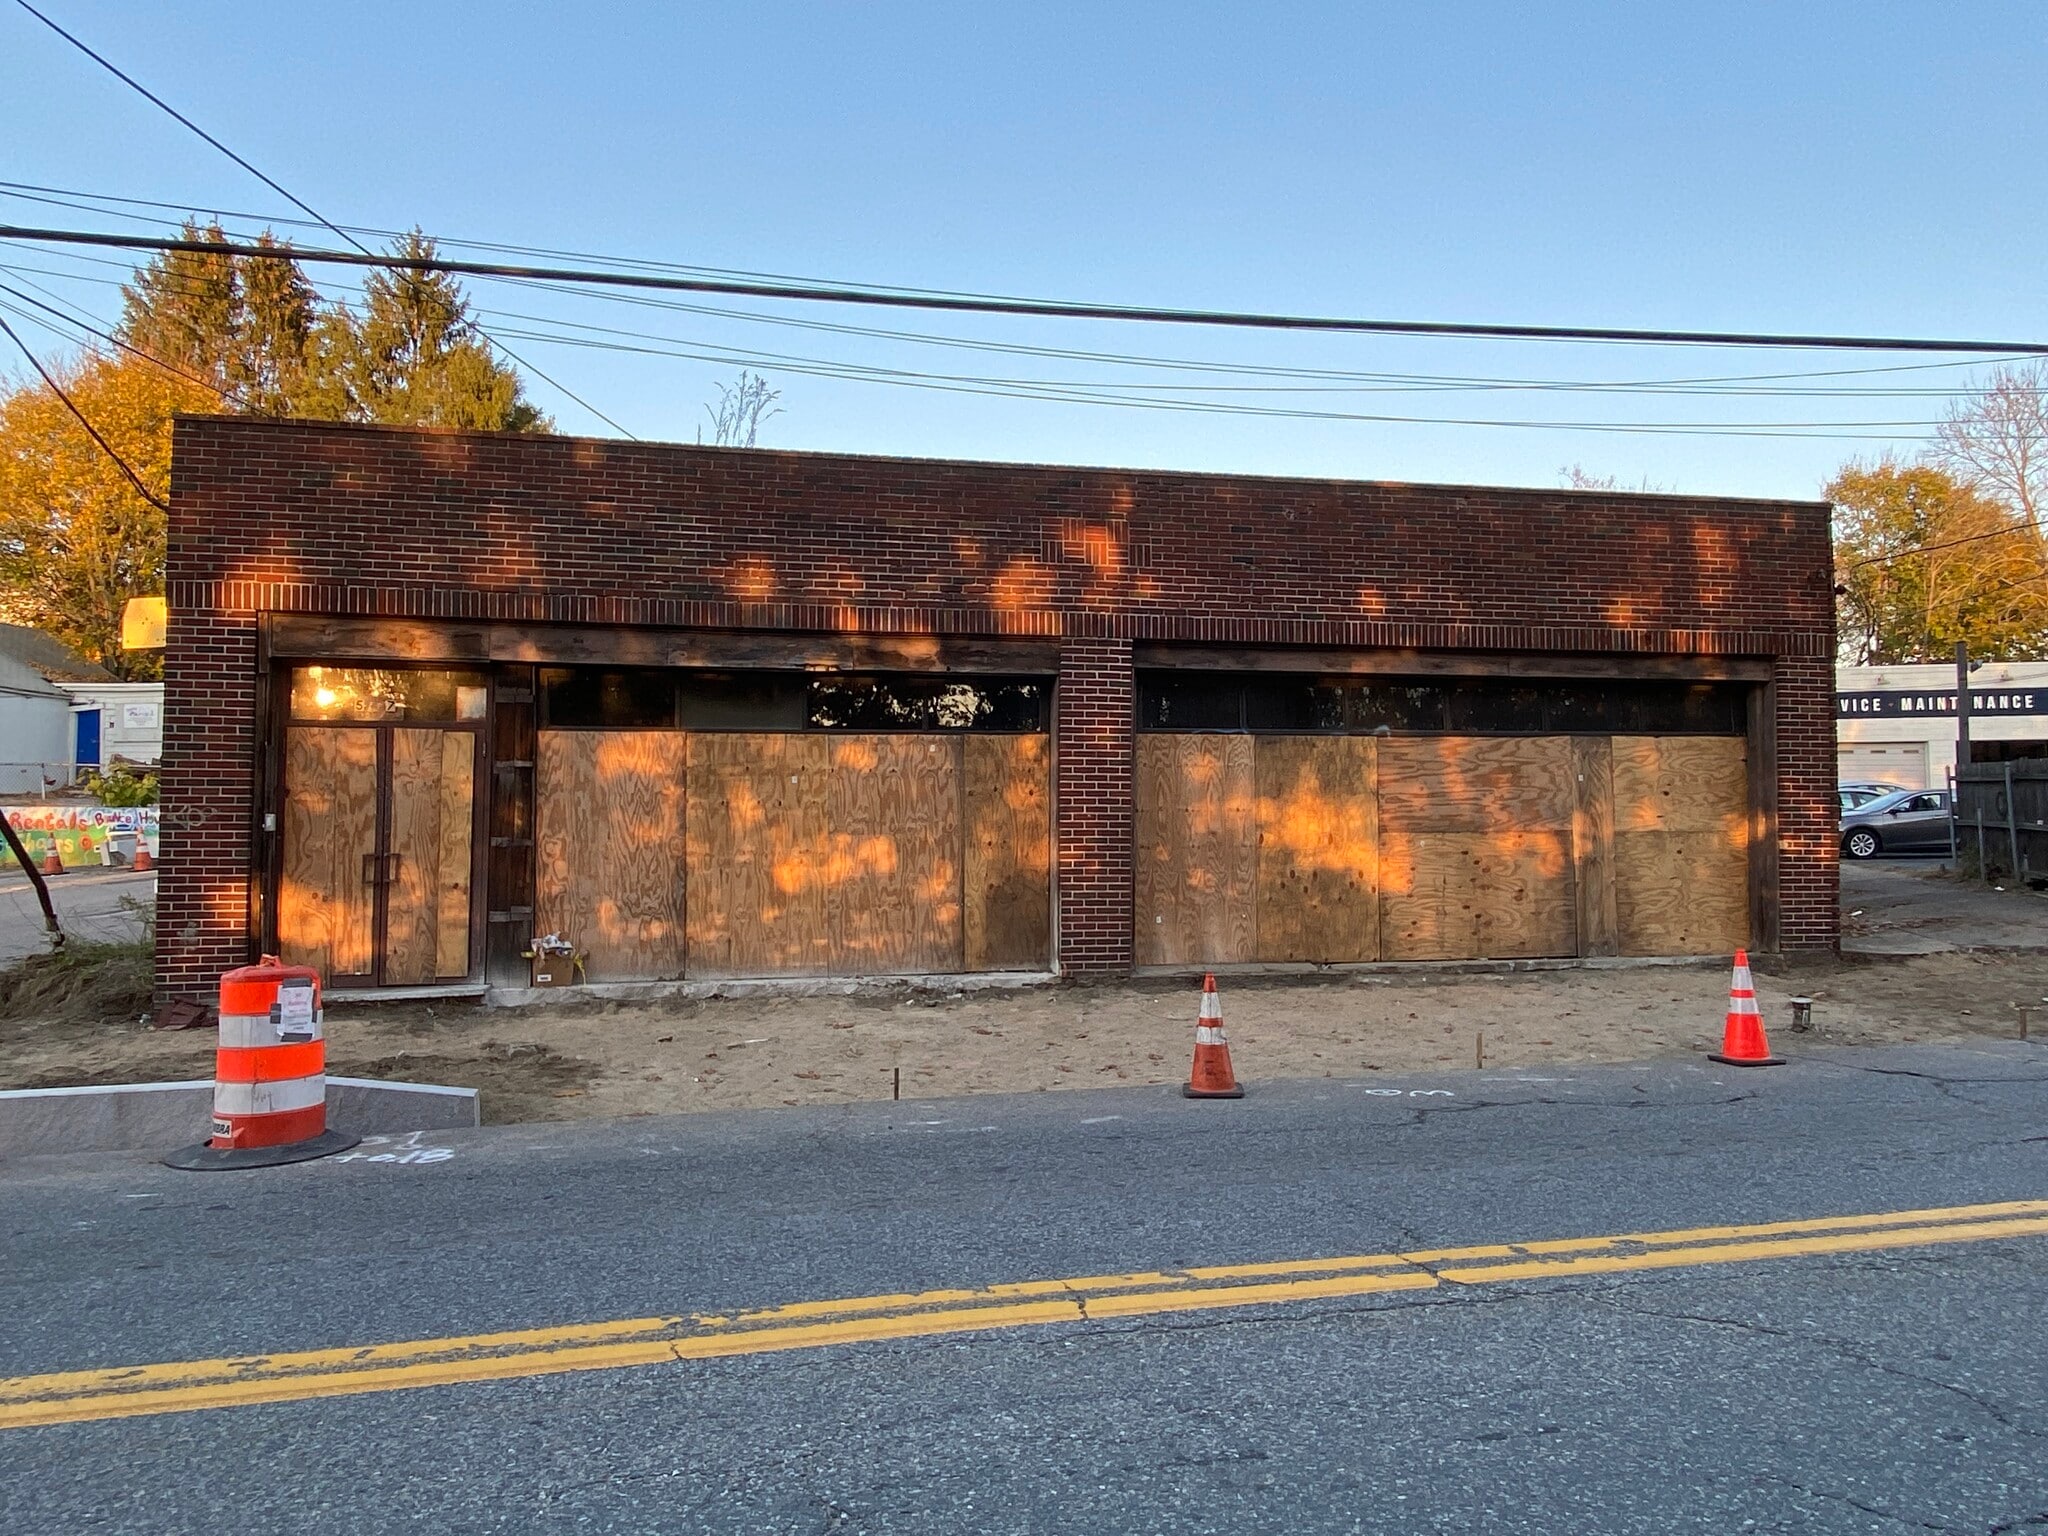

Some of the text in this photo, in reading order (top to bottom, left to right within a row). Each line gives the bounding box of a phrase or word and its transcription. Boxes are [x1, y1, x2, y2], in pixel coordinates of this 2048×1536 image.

[1840, 694, 2035, 713] VICE MAINTNANCE
[9, 812, 88, 831] Rentals
